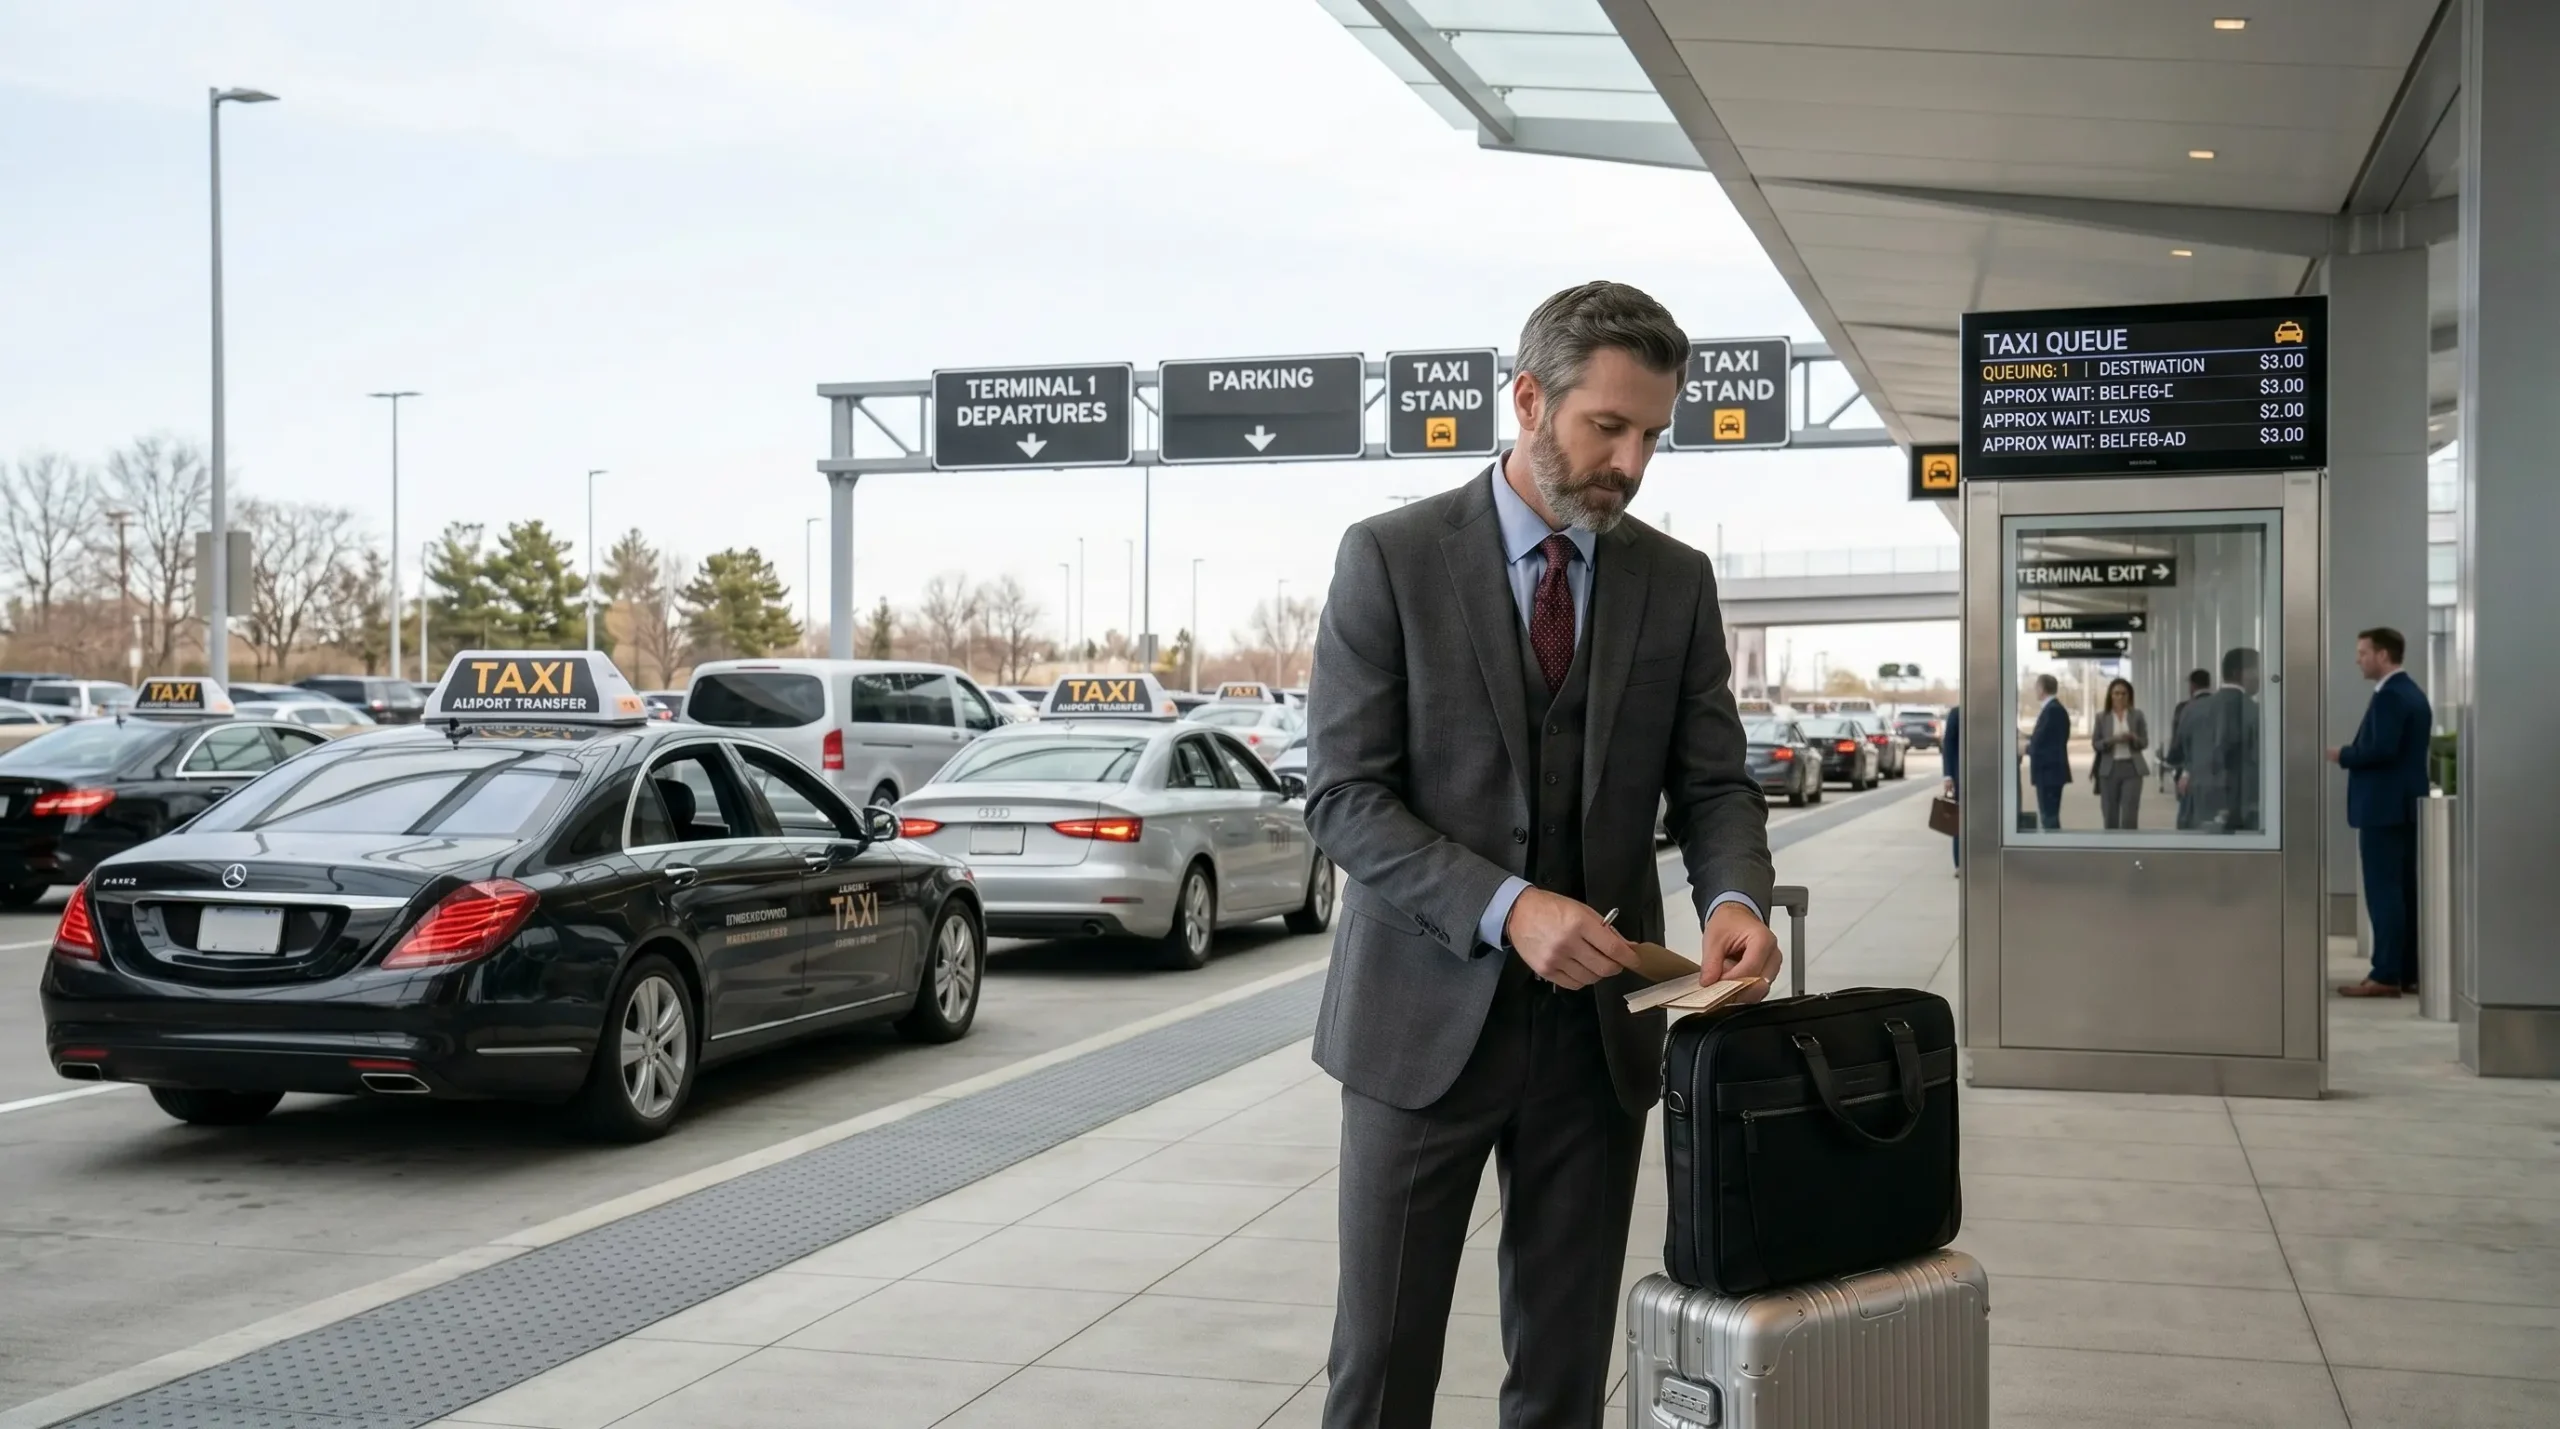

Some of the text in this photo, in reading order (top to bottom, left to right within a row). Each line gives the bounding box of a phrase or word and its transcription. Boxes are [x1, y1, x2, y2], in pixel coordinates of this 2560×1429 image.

[1983, 328, 2128, 355] TAXI QUEUE
[1413, 360, 1469, 383] TAXI
[1700, 350, 1759, 373] TAXI
[1982, 365, 2057, 382] QUEUING:
[2061, 362, 2069, 377] 1
[2259, 353, 2304, 370] $3.00
[966, 375, 1096, 400] TERMINAL 1
[1208, 367, 1314, 391] PARKING
[1685, 379, 1775, 403] STAND
[1400, 389, 1483, 412] STAND
[1982, 387, 2048, 405] APPROX
[2051, 386, 2095, 402] WAIT:
[2259, 378, 2304, 395] $3.00
[957, 401, 1107, 427] DEPARTURES
[1982, 403, 2304, 429] APPROX WAIT: LEXUS $2.00
[1982, 435, 2048, 453] APPROX
[2051, 434, 2095, 450] WAIT:
[2259, 427, 2304, 444] $3.00
[2017, 565, 2146, 584] TERMINAL EXIT
[2043, 617, 2073, 630] TAXI
[471, 661, 574, 694] TAXI
[149, 683, 197, 701] TAXI
[1067, 680, 1136, 702] TAXI
[516, 697, 587, 710] TRANSFER
[830, 892, 879, 931] TAXI
